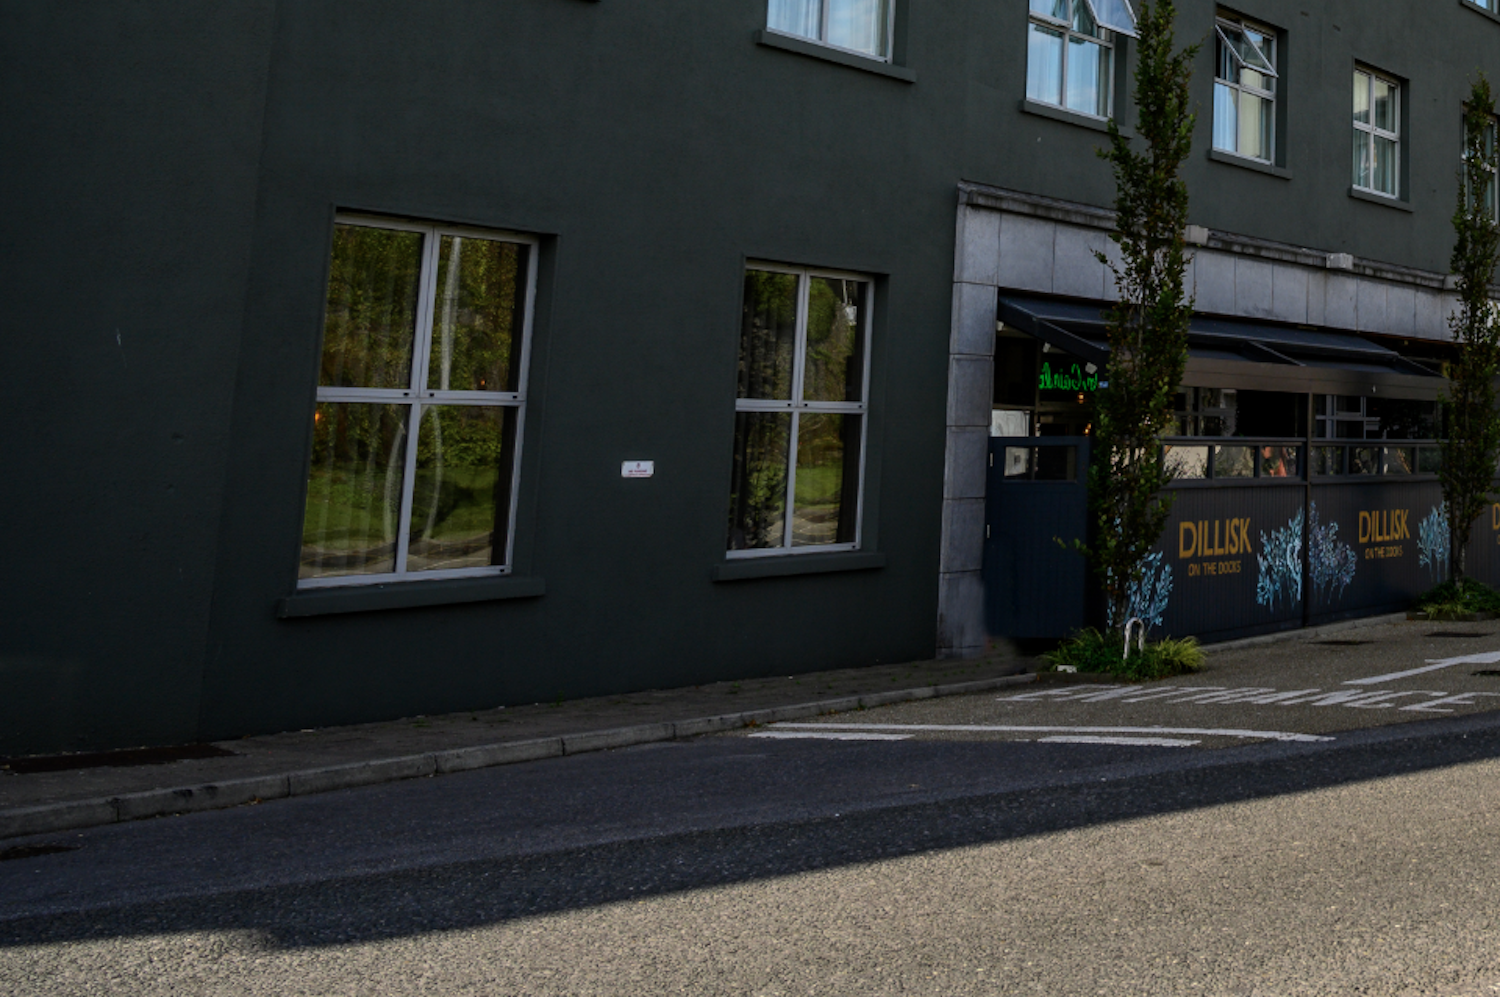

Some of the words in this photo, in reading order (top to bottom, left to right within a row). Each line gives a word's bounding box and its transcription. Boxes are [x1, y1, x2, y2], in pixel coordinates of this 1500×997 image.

[1179, 517, 1252, 558] DILLISK
[1359, 509, 1410, 543] DILLISK
[1188, 563, 1200, 576] ON
[1203, 562, 1217, 575] THE
[1218, 560, 1241, 574] DOCKS
